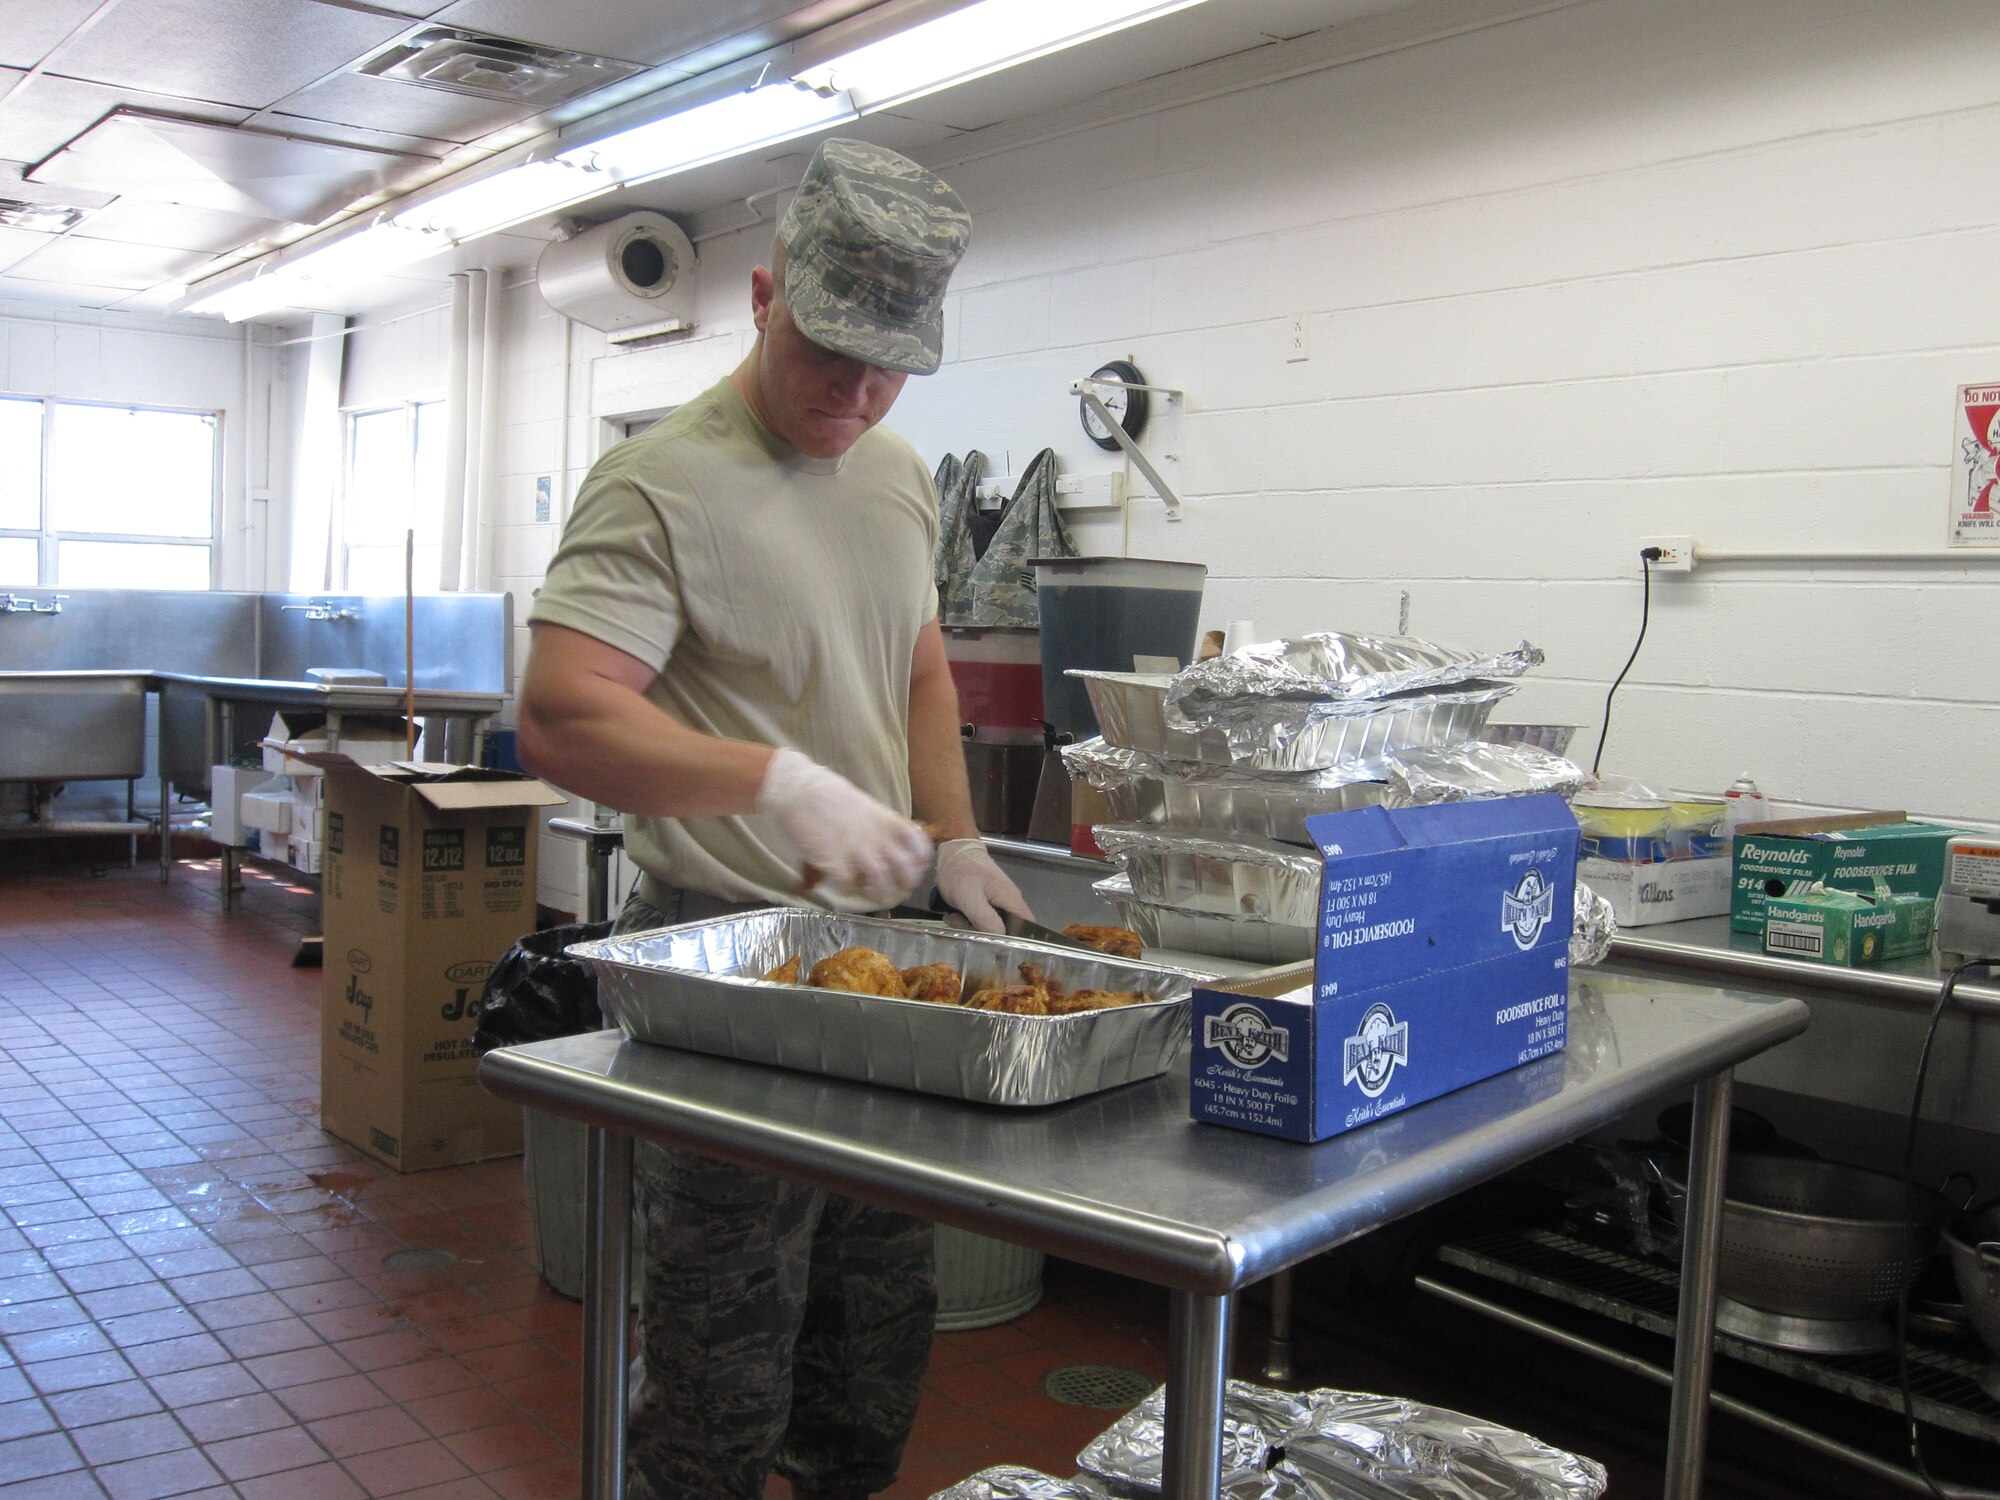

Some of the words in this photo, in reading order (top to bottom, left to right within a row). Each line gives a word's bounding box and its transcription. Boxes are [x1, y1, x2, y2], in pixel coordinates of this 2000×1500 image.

[1323, 844, 1343, 856] 6045
[1741, 843, 1810, 864] Reynolds
[1834, 845, 1866, 860] Reynolds
[1739, 864, 1792, 876] FOODSERVICE
[1793, 868, 1813, 877] FILM
[1834, 864, 1894, 879] FOODSERVICE
[1896, 863, 1917, 875] FILM
[1326, 899, 1335, 912] FT
[1337, 896, 1350, 911] 500
[1359, 894, 1368, 906] IN
[1369, 892, 1377, 905] 18
[1325, 915, 1342, 929] Duty
[1344, 911, 1366, 925] Heavy
[1768, 906, 1824, 922] Handgards
[1854, 910, 1896, 929] Handgards
[1354, 918, 1415, 945] FOODSERVICE
[1332, 931, 1352, 949] FOIL
[1321, 982, 1338, 997] 6045
[1496, 999, 1543, 1025] FOODSERVICE
[1544, 994, 1560, 1010] FOIL
[1536, 1015, 1551, 1028] Heavy
[1552, 1010, 1565, 1023] Duty
[1528, 1033, 1534, 1045] 18
[1535, 1031, 1541, 1043] IN
[1542, 1029, 1547, 1040] X
[1547, 1026, 1557, 1038] 500
[1557, 1023, 1565, 1034] FT
[434, 1041, 457, 1051] HOT
[1207, 1065, 1240, 1079] Keith's
[1243, 1070, 1284, 1087] Essentials
[1194, 1078, 1215, 1090] 6045
[1223, 1083, 1250, 1097] Heavy
[1252, 1088, 1272, 1102] Duty
[1213, 1093, 1223, 1103] 18
[1226, 1096, 1236, 1106] IN
[1238, 1098, 1244, 1107] X
[1247, 1099, 1262, 1111] 500
[1265, 1103, 1275, 1113] FT
[1345, 1103, 1374, 1127] Keith's
[1375, 1093, 1406, 1117] Essentials
[1205, 1104, 1239, 1118] (45.7cm
[1248, 1113, 1283, 1128] 152.4m)
